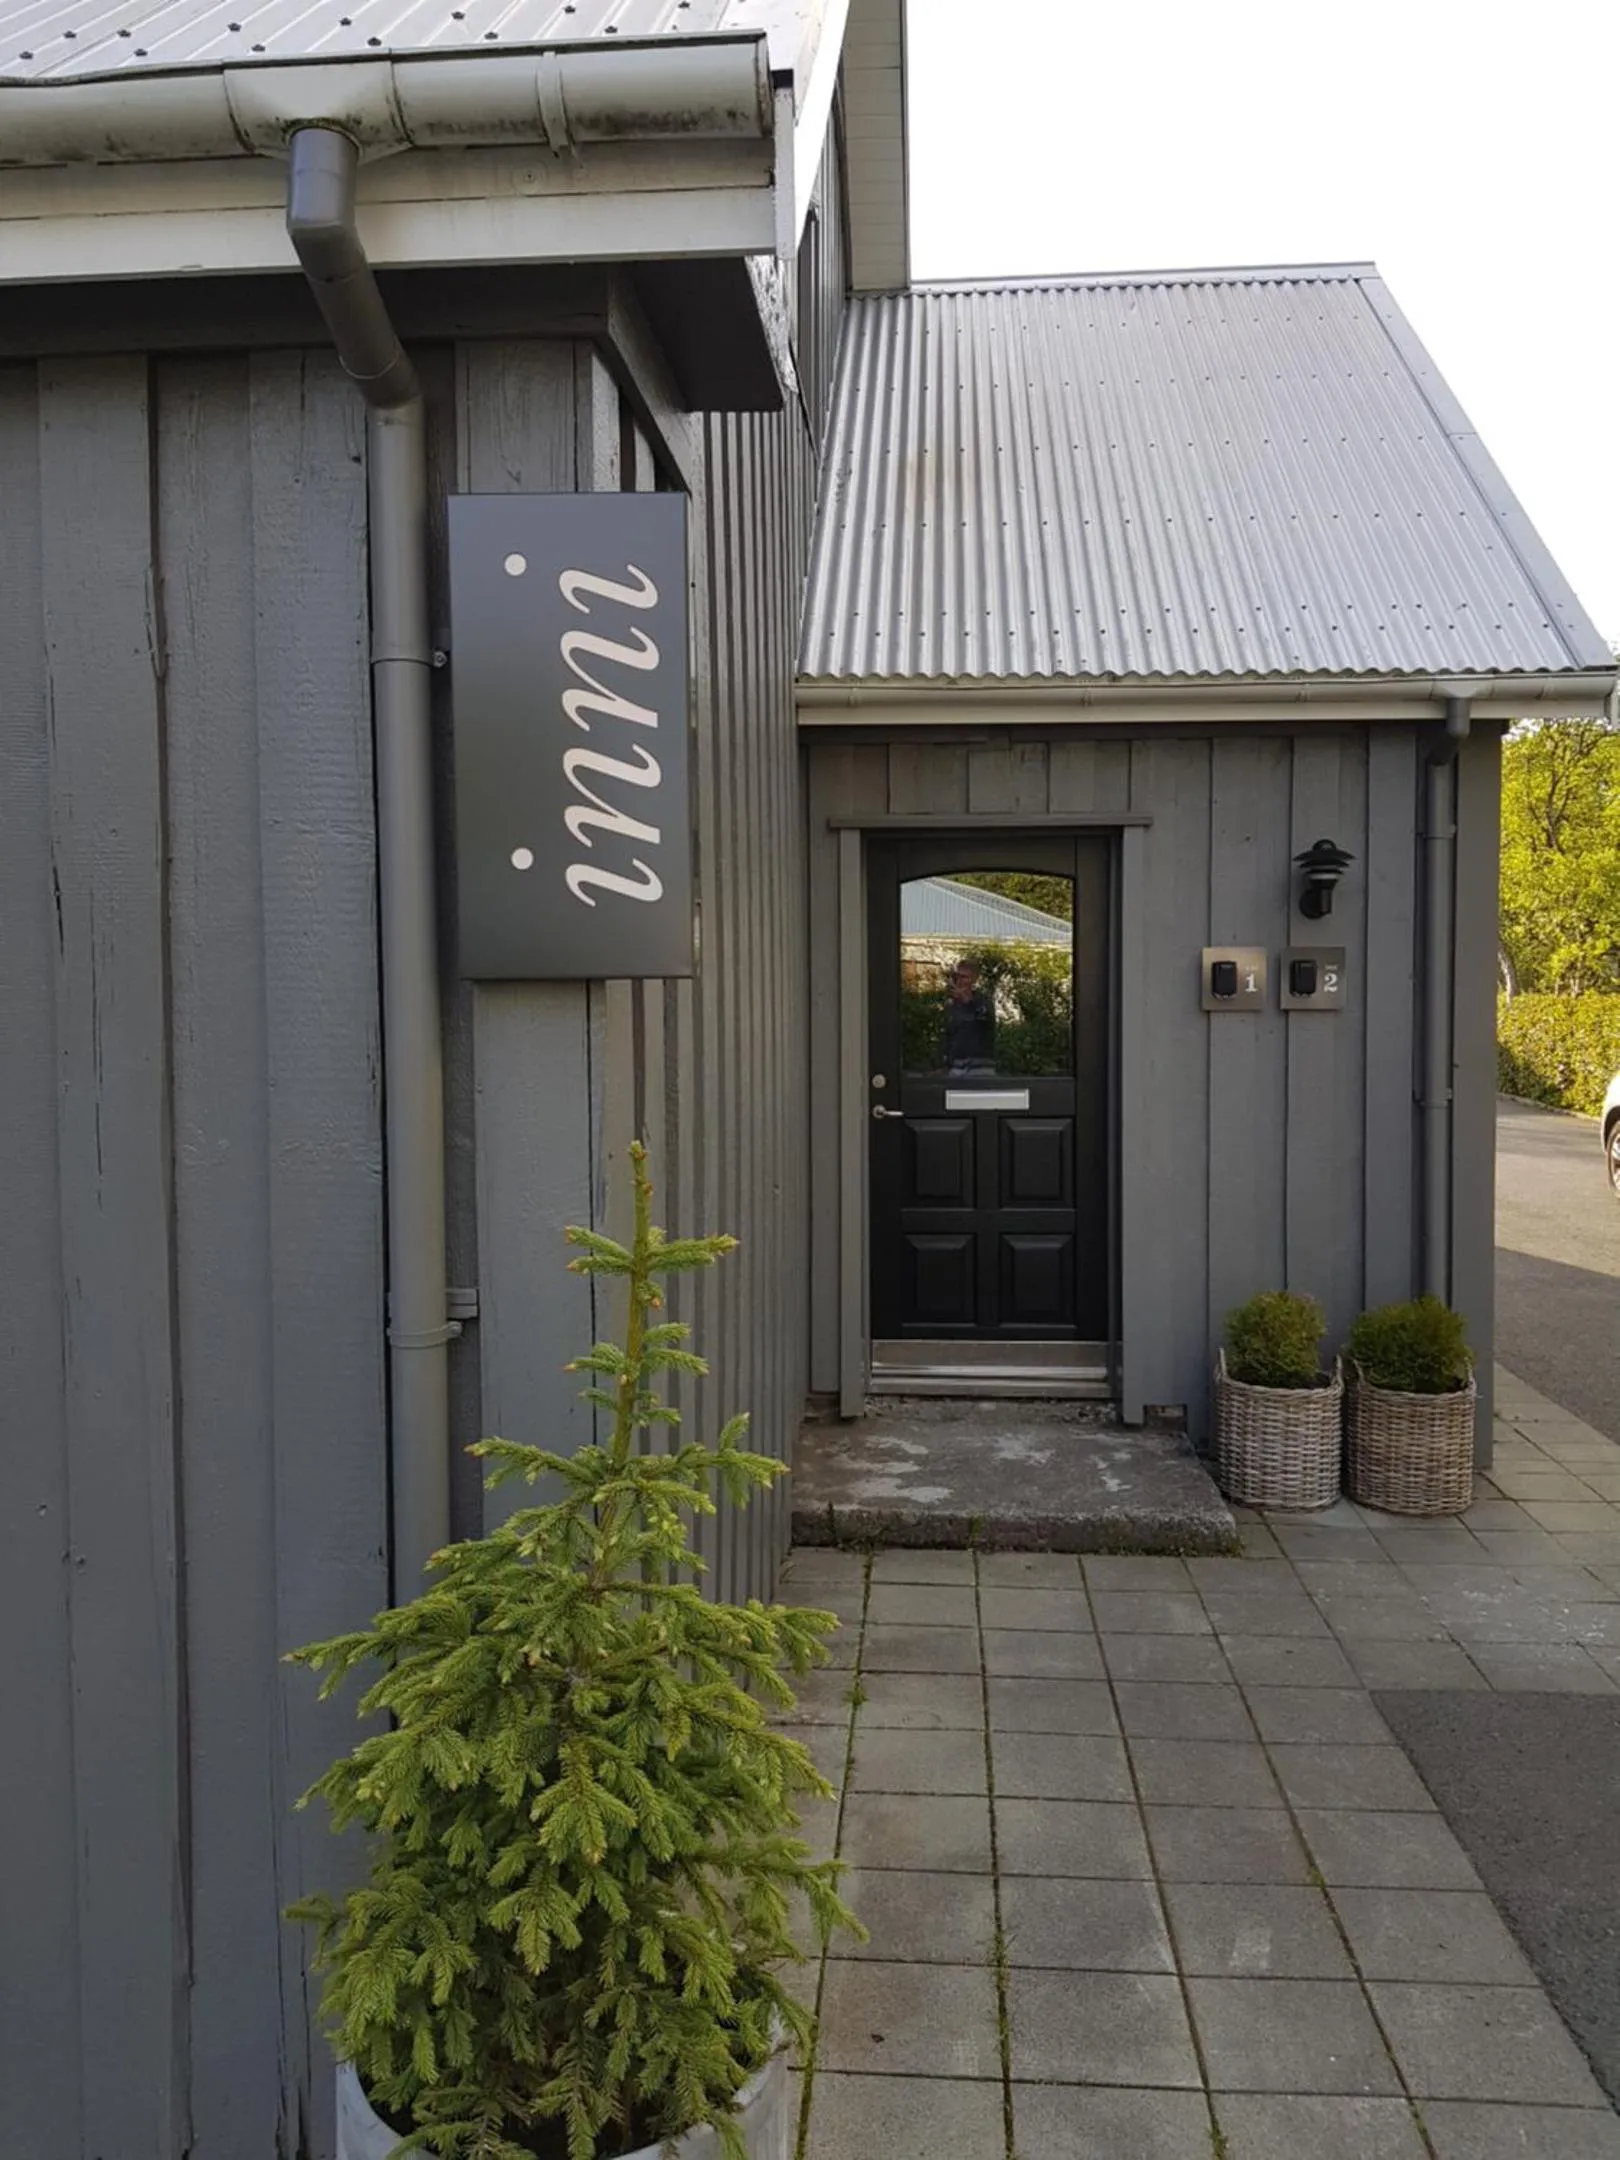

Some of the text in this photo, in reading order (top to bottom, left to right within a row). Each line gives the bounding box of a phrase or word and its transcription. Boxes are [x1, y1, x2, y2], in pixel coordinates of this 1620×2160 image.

[504, 553, 664, 907] inni
[1245, 973, 1258, 992] 1
[1323, 973, 1338, 992] 2
